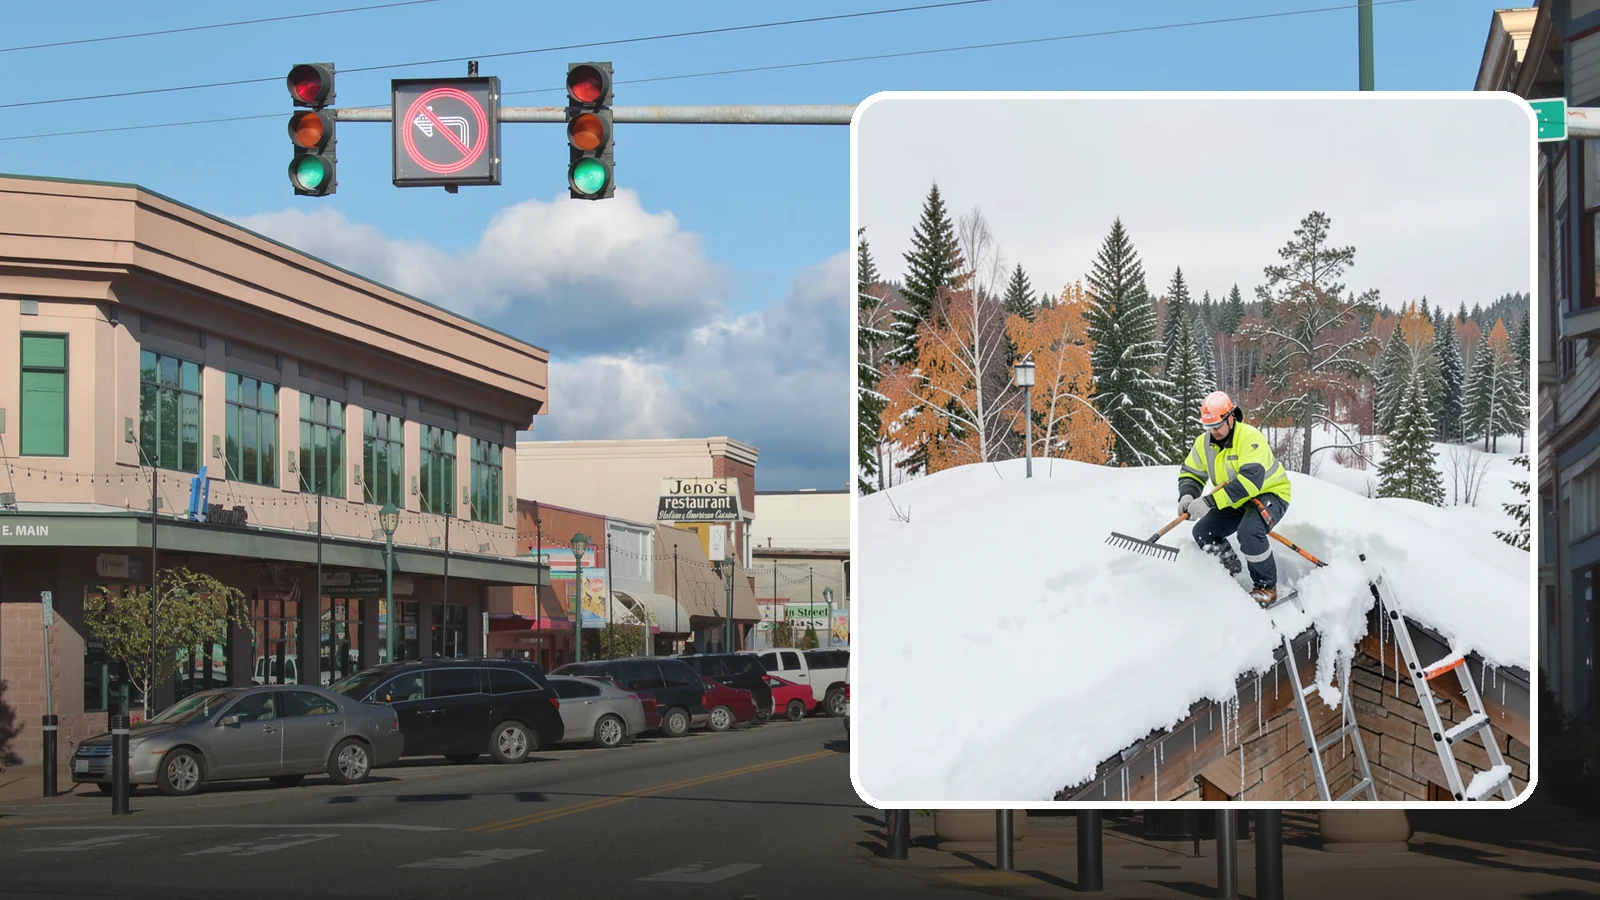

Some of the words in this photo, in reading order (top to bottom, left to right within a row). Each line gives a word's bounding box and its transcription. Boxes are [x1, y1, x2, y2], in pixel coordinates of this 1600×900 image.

[670, 480, 727, 494] Jeno's
[665, 496, 730, 509] restaurant
[659, 510, 682, 519] Italian
[686, 510, 714, 519] American
[715, 510, 737, 519] Cuisine
[2, 525, 13, 536] E.
[16, 525, 48, 536] MAIN
[786, 608, 794, 616] in
[798, 608, 828, 616] Street
